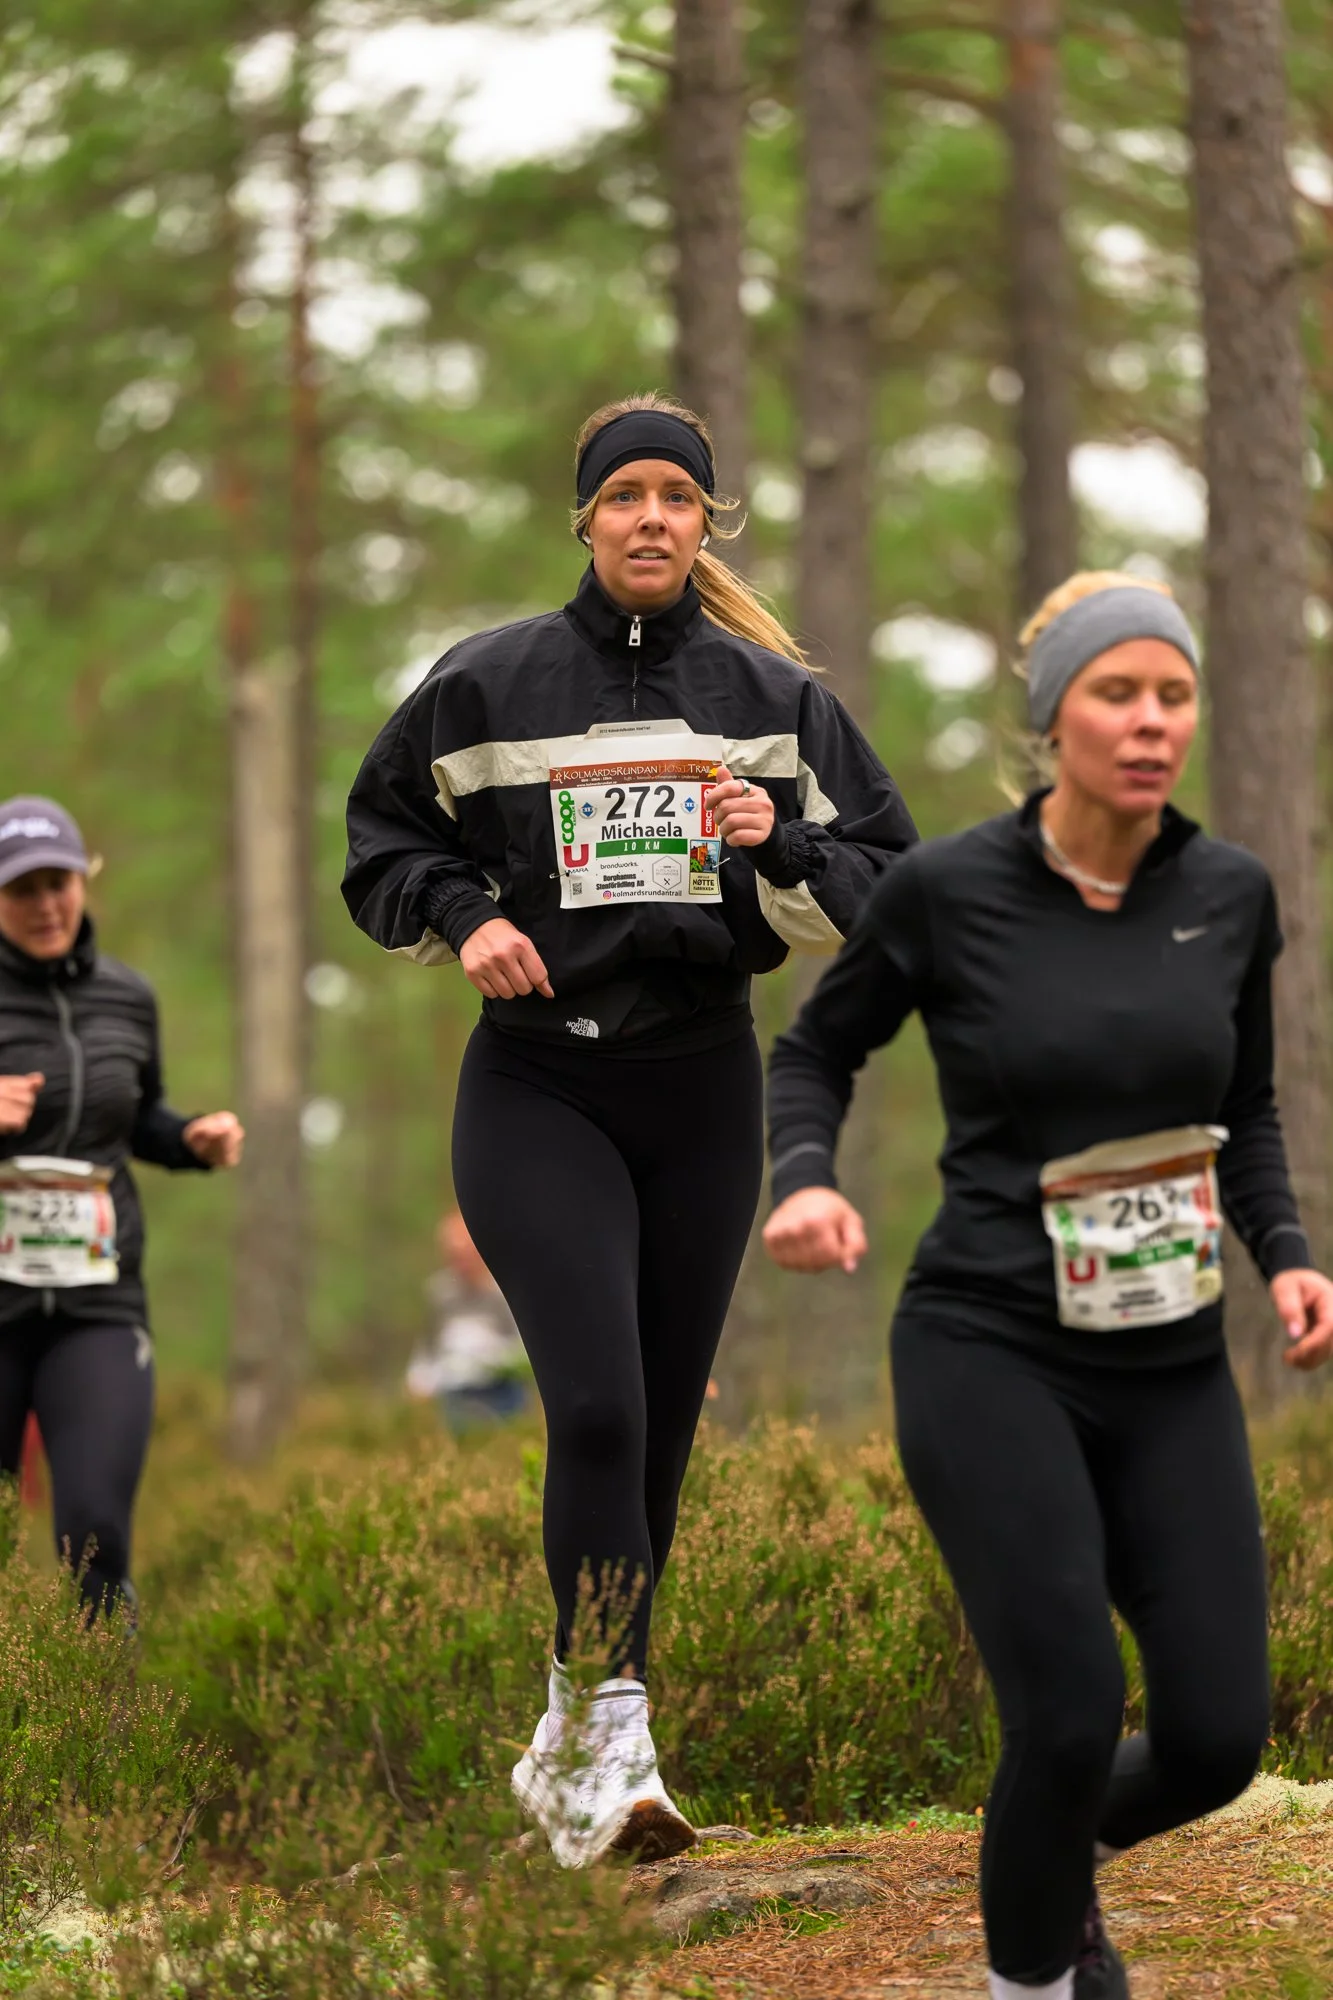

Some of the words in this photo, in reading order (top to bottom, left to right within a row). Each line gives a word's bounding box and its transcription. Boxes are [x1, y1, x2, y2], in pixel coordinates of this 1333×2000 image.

[604, 785, 676, 821] 272
[558, 790, 575, 844] coop
[705, 809, 713, 834] CIRC
[601, 821, 683, 840] Michaela
[623, 841, 637, 851] 10
[644, 841, 660, 851] KM
